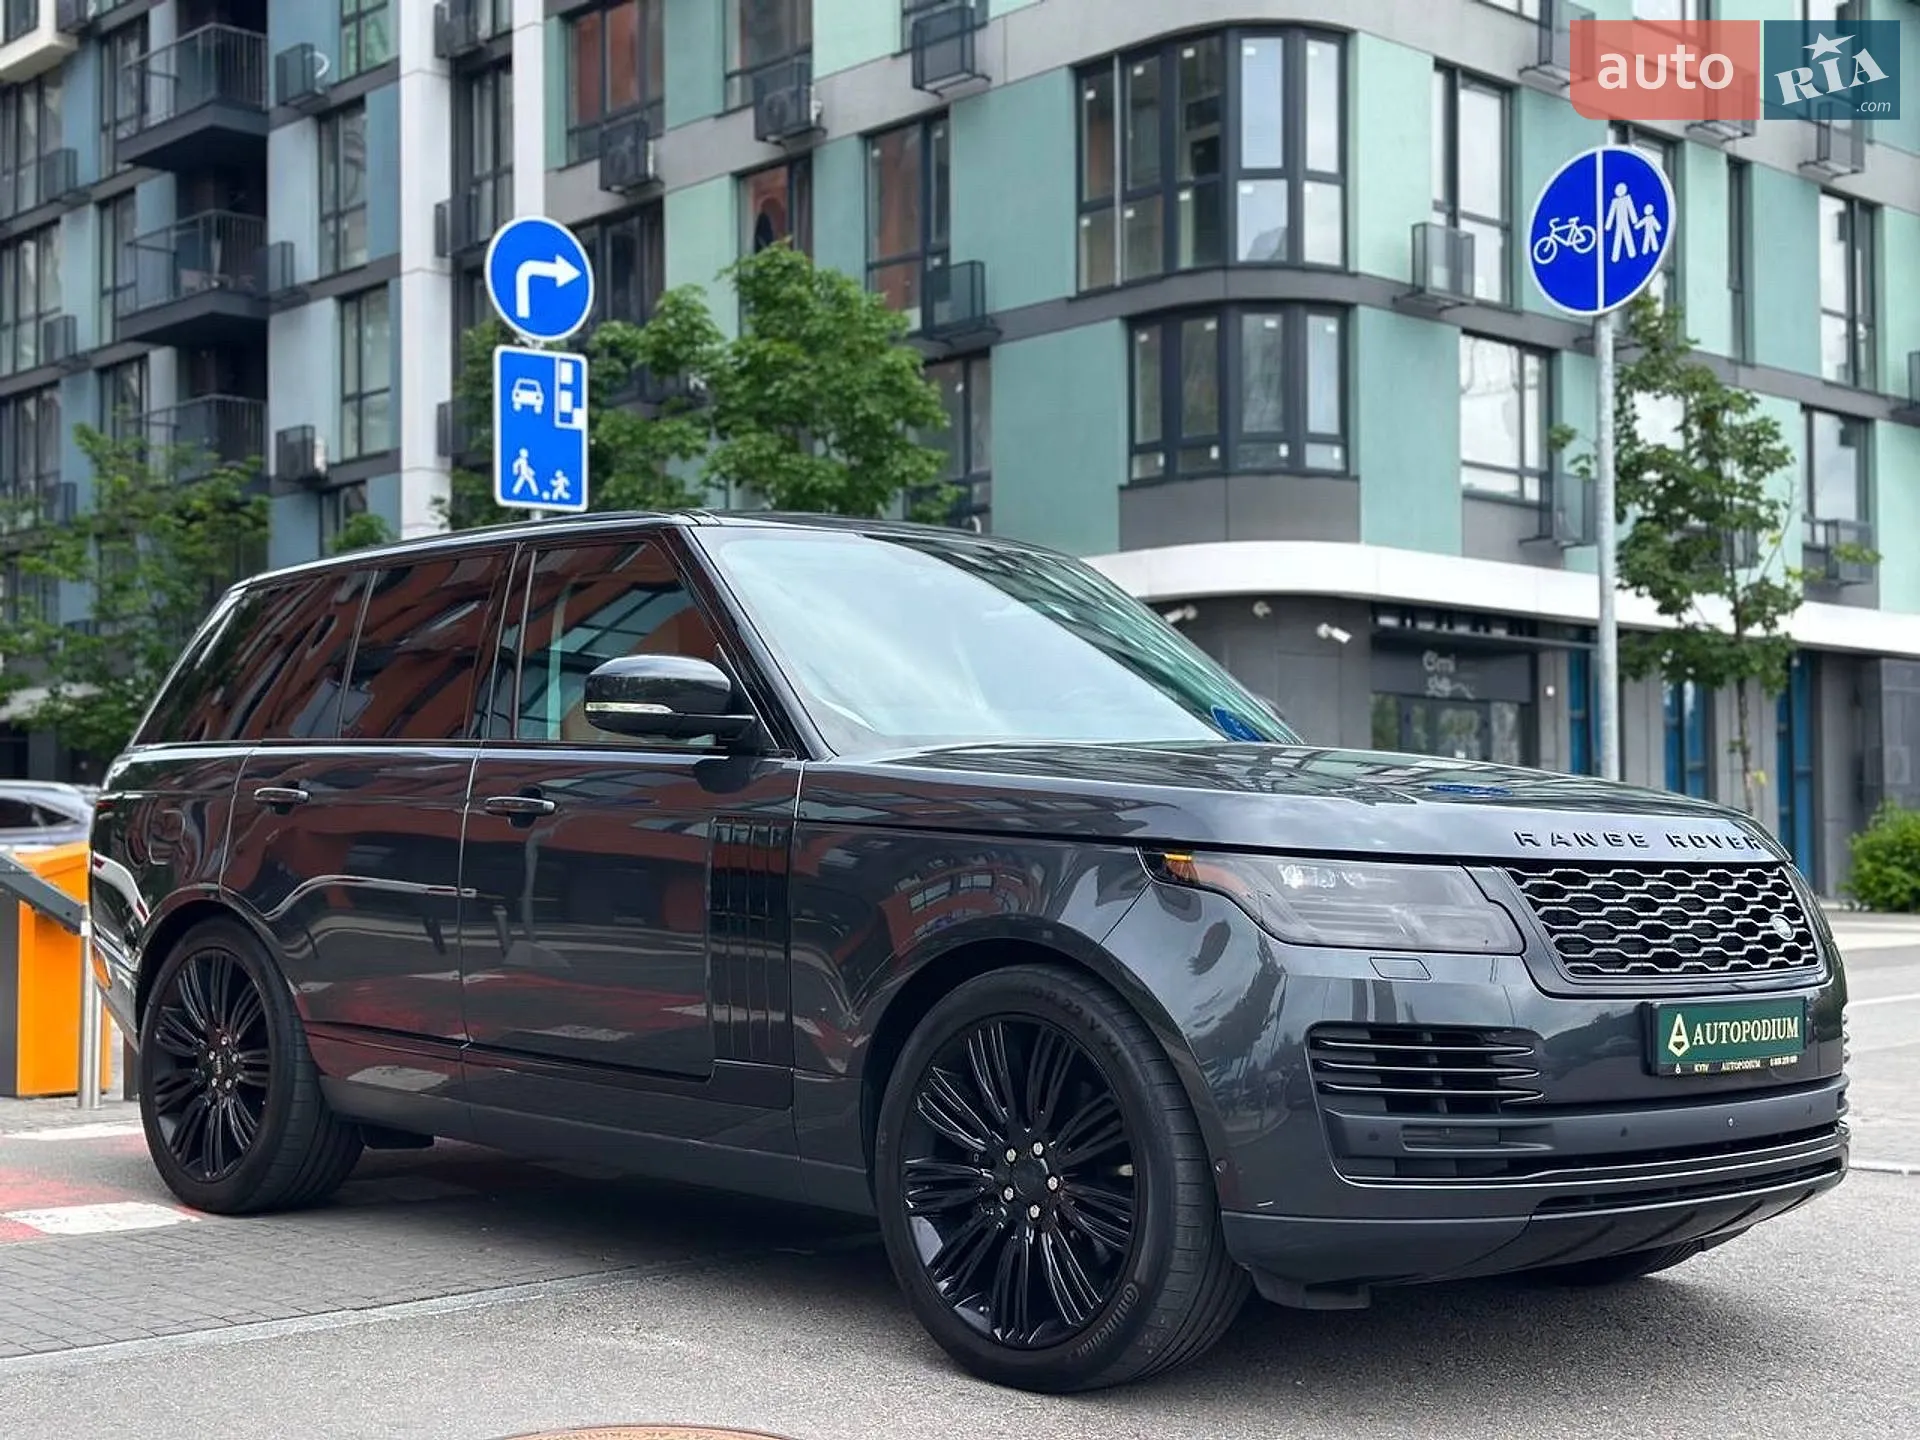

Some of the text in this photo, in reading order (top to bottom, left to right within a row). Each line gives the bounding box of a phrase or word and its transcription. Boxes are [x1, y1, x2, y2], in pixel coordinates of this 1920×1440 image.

[1513, 831, 1764, 849] RANGE ROVER
[1692, 1016, 1799, 1046] AUTOPODIUM
